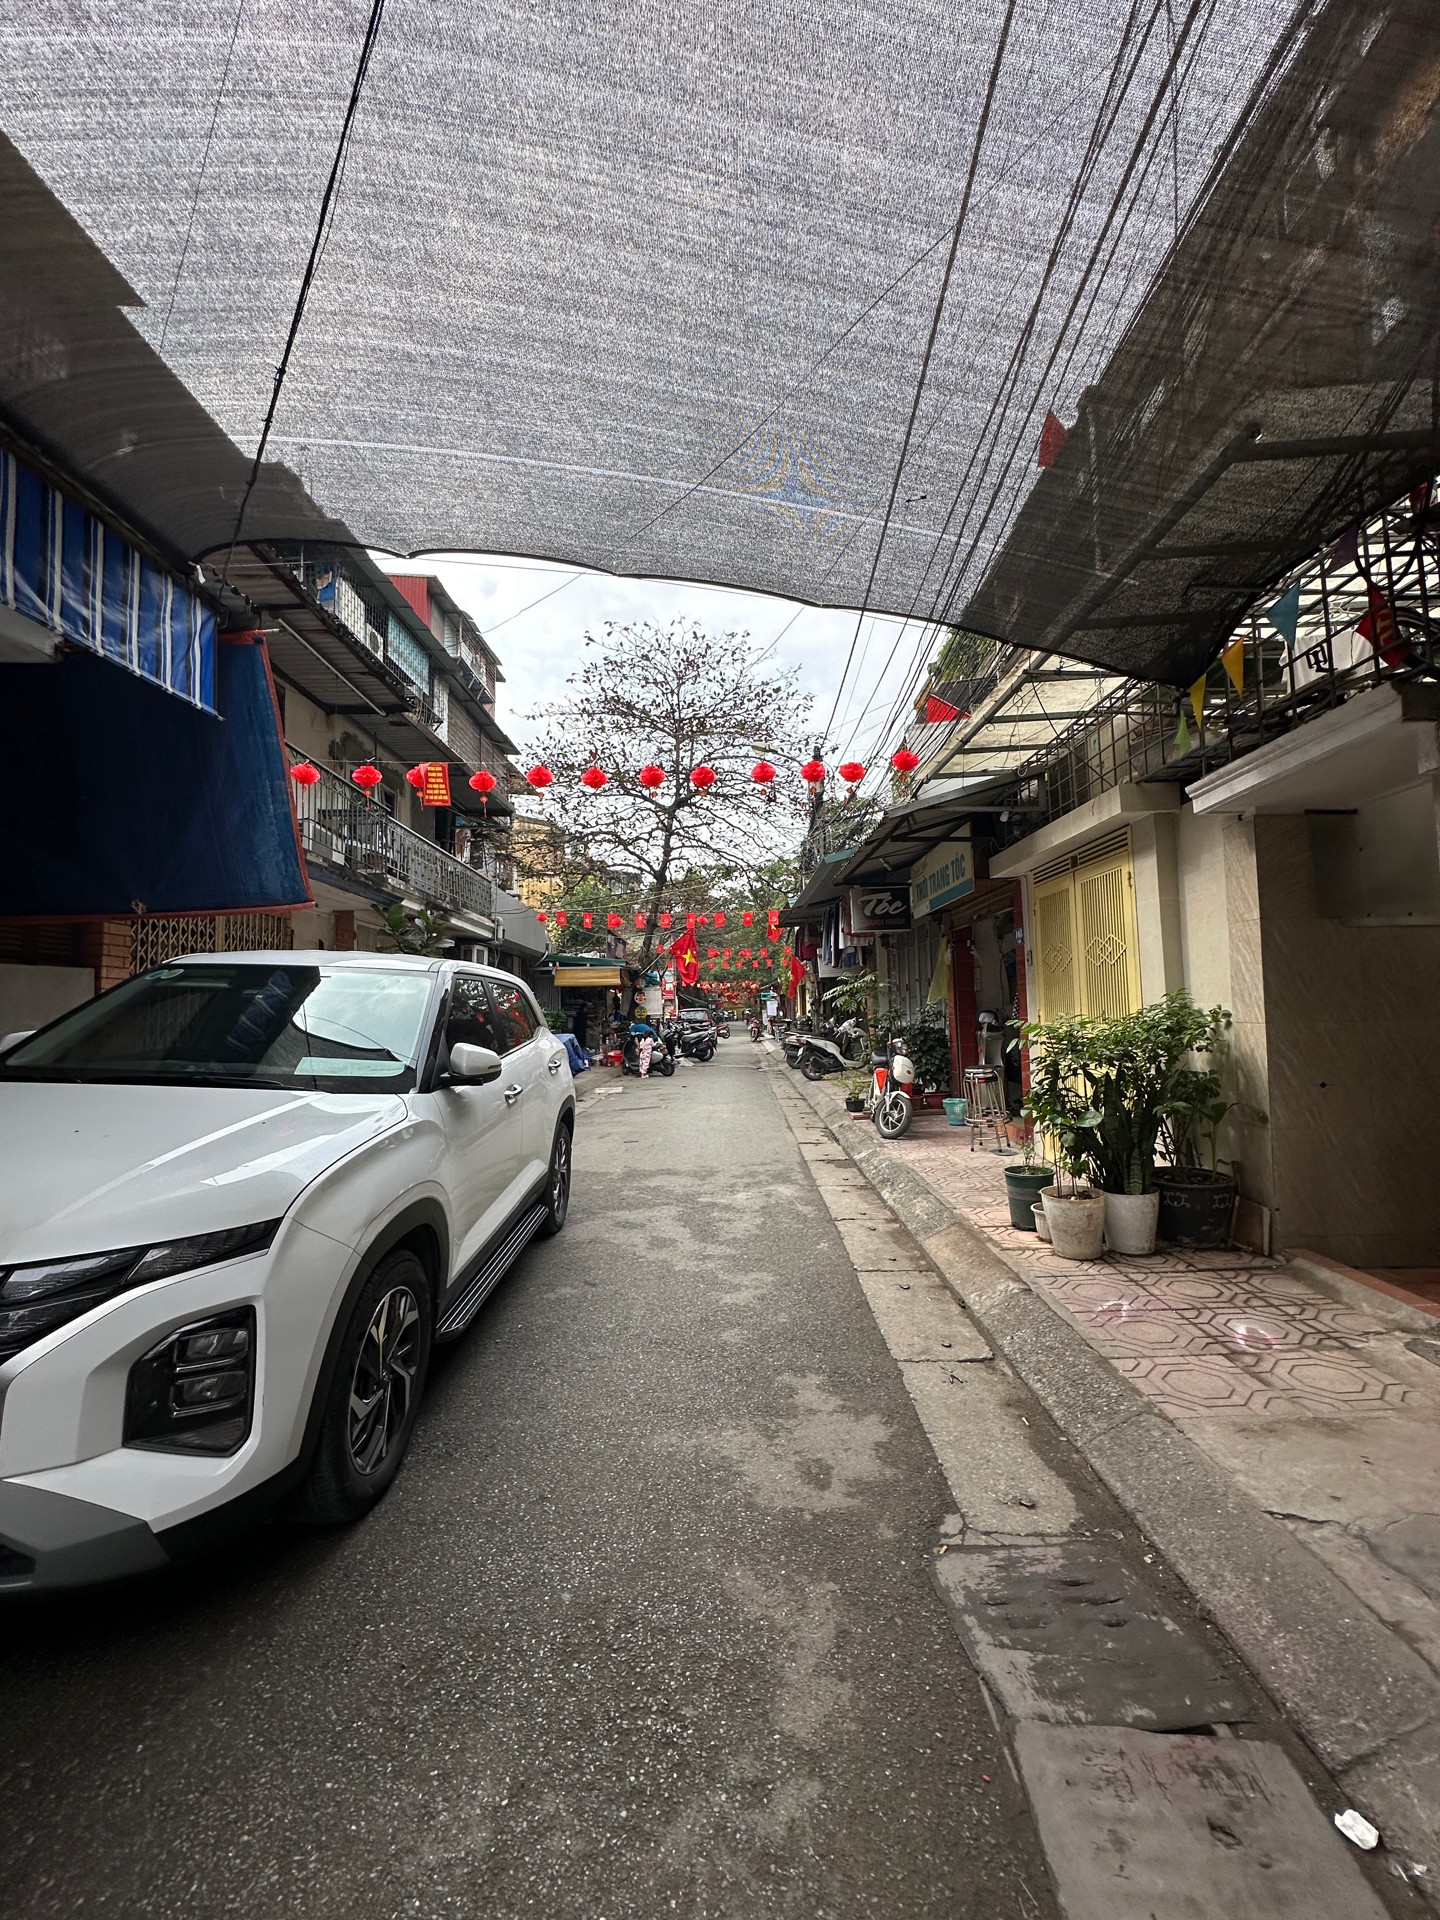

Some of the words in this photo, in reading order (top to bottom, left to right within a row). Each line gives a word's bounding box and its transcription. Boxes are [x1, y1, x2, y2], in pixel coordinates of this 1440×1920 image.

[928, 863, 951, 896] TRANG
[951, 851, 966, 883] TÓC
[857, 891, 907, 917] Tóc
